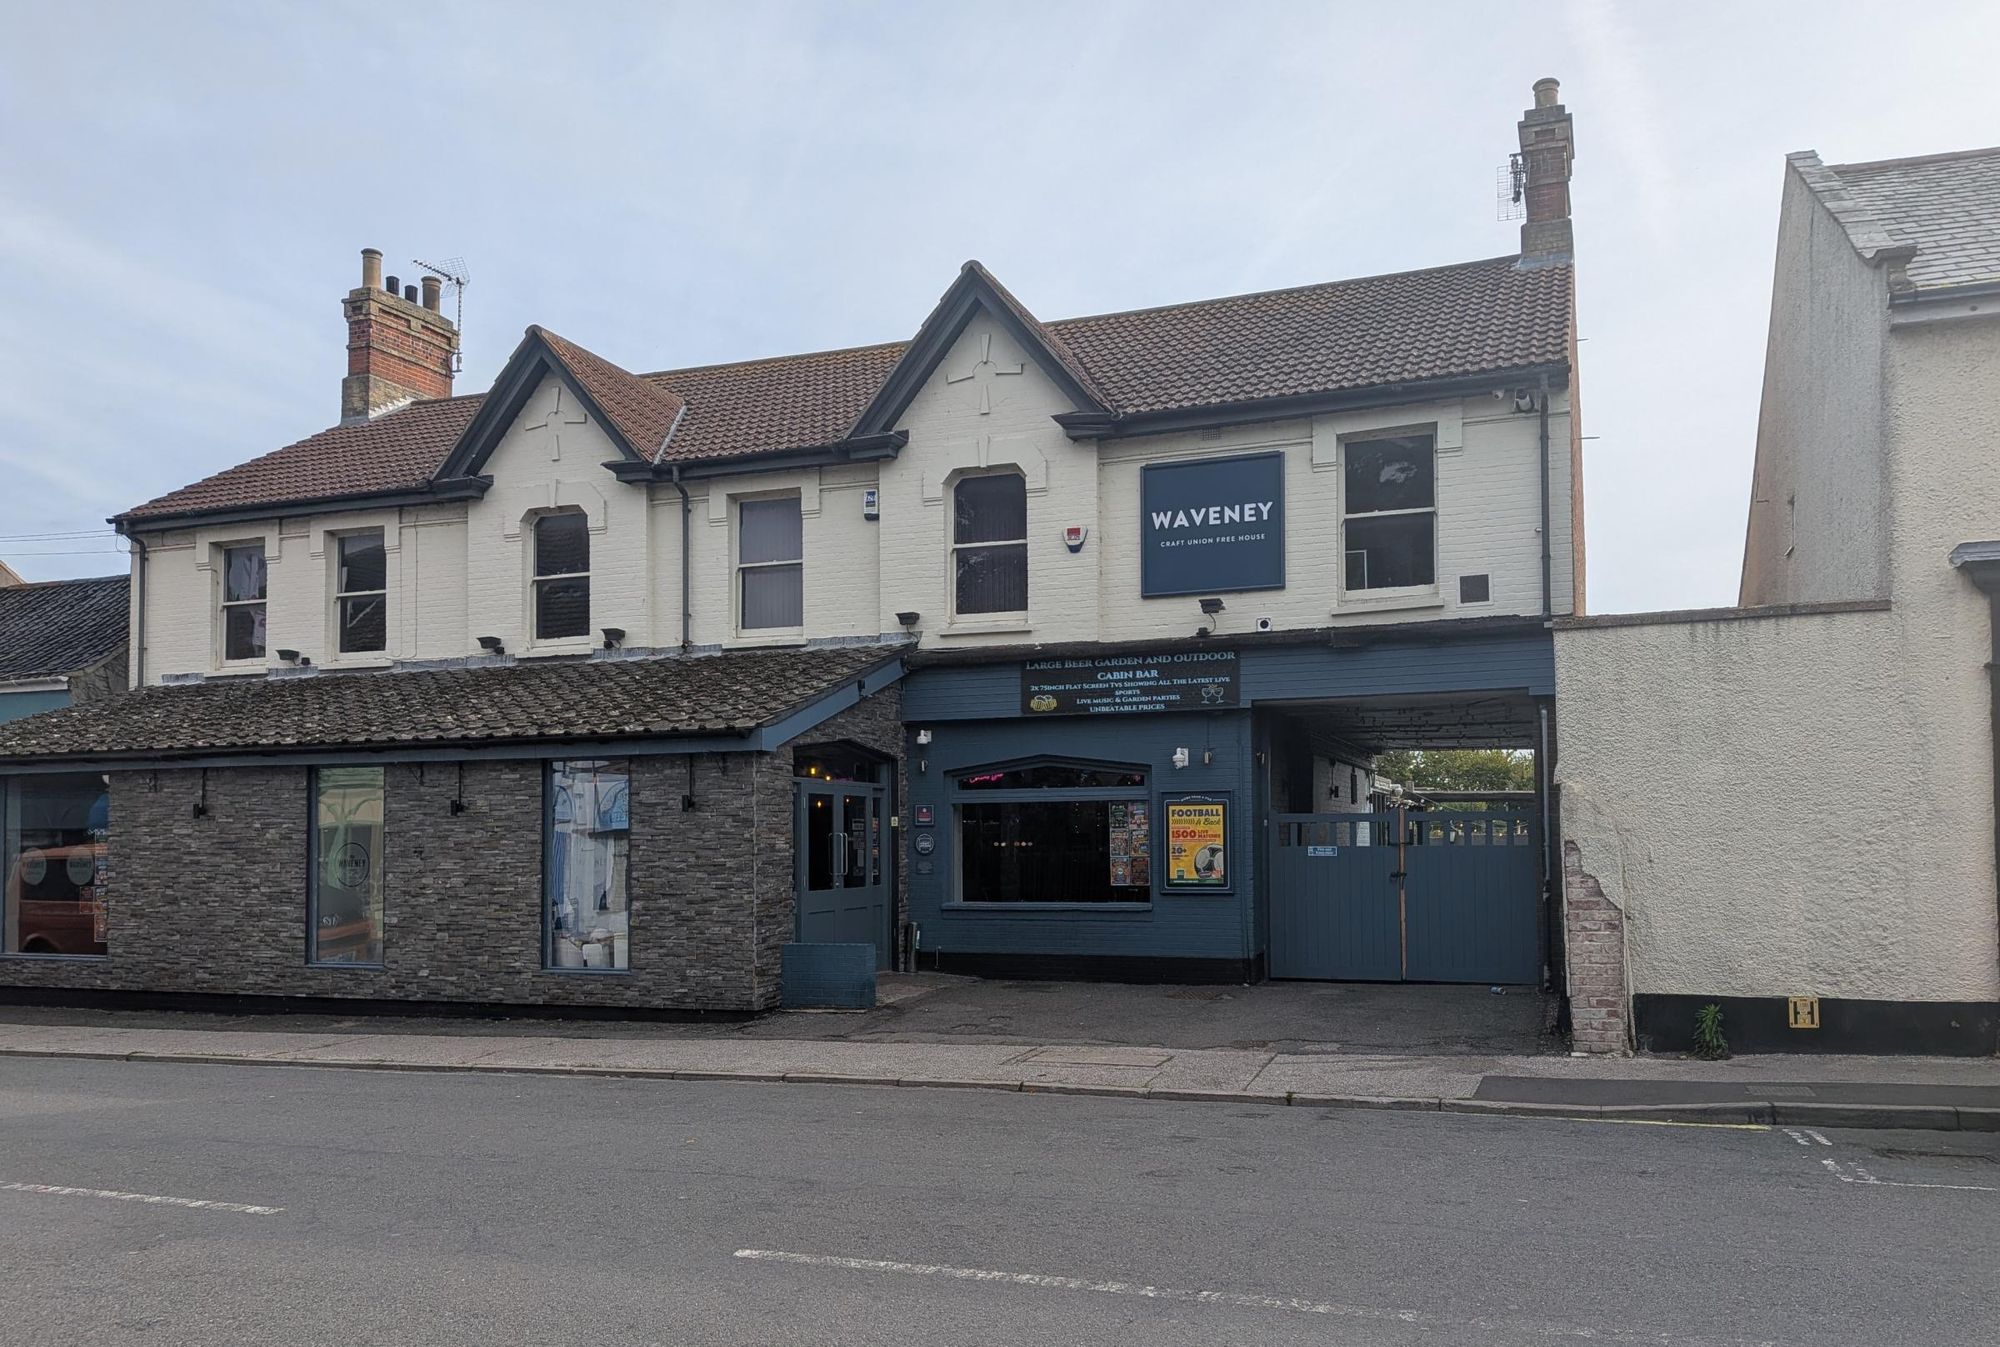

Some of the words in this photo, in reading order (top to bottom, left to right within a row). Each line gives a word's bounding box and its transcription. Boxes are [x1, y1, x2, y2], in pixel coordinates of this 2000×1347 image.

[1151, 501, 1273, 530] WAVENEY
[1160, 539, 1185, 548] CRAFT
[1187, 538, 1214, 546] UNION
[1216, 535, 1236, 543] FREE
[1238, 533, 1265, 542] HOUSE
[1026, 661, 1062, 670] LARGE
[1064, 660, 1093, 669] BEER
[1095, 657, 1143, 667] GARDEN
[1144, 655, 1171, 664] AND
[1174, 651, 1236, 663] OUTDOOR
[1097, 671, 1133, 680] CABIN
[1136, 669, 1159, 679] BAR
[1124, 680, 1157, 688] SHOWING
[1090, 704, 1138, 713] UNBEATABLE
[1138, 703, 1165, 711] PRICES
[1171, 808, 1221, 817] FOOTBALL
[1171, 830, 1197, 839] 1500
[1793, 1001, 1815, 1025] H
